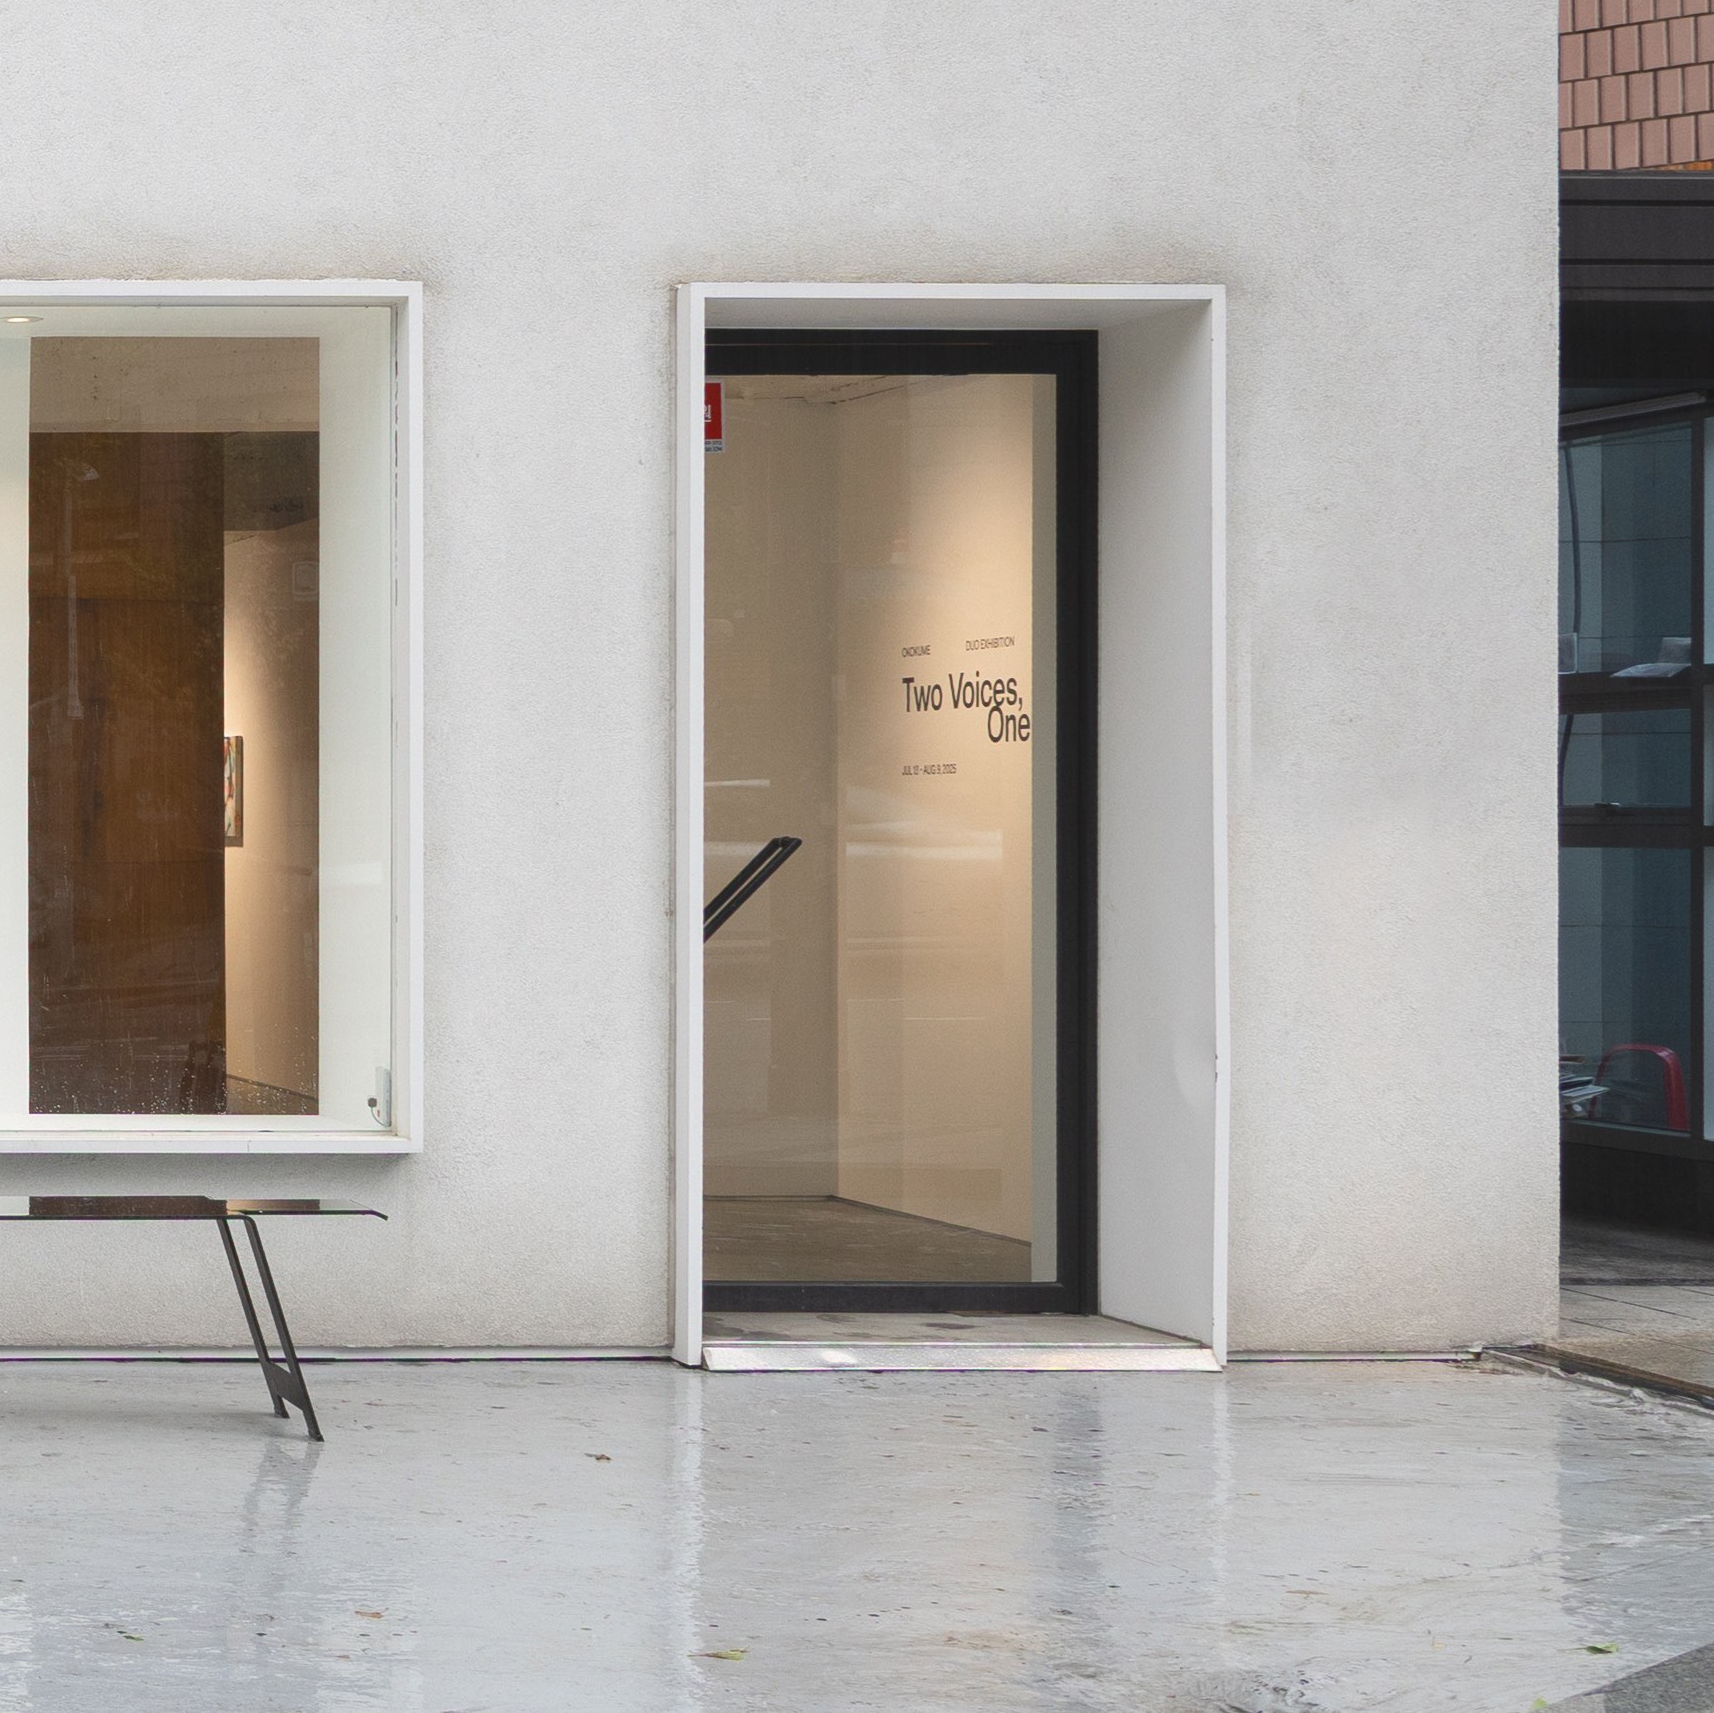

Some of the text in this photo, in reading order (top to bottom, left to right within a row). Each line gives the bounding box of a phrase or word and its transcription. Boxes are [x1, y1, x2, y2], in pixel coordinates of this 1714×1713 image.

[902, 670, 1023, 712] Two Voices,
[987, 706, 1030, 743] One
